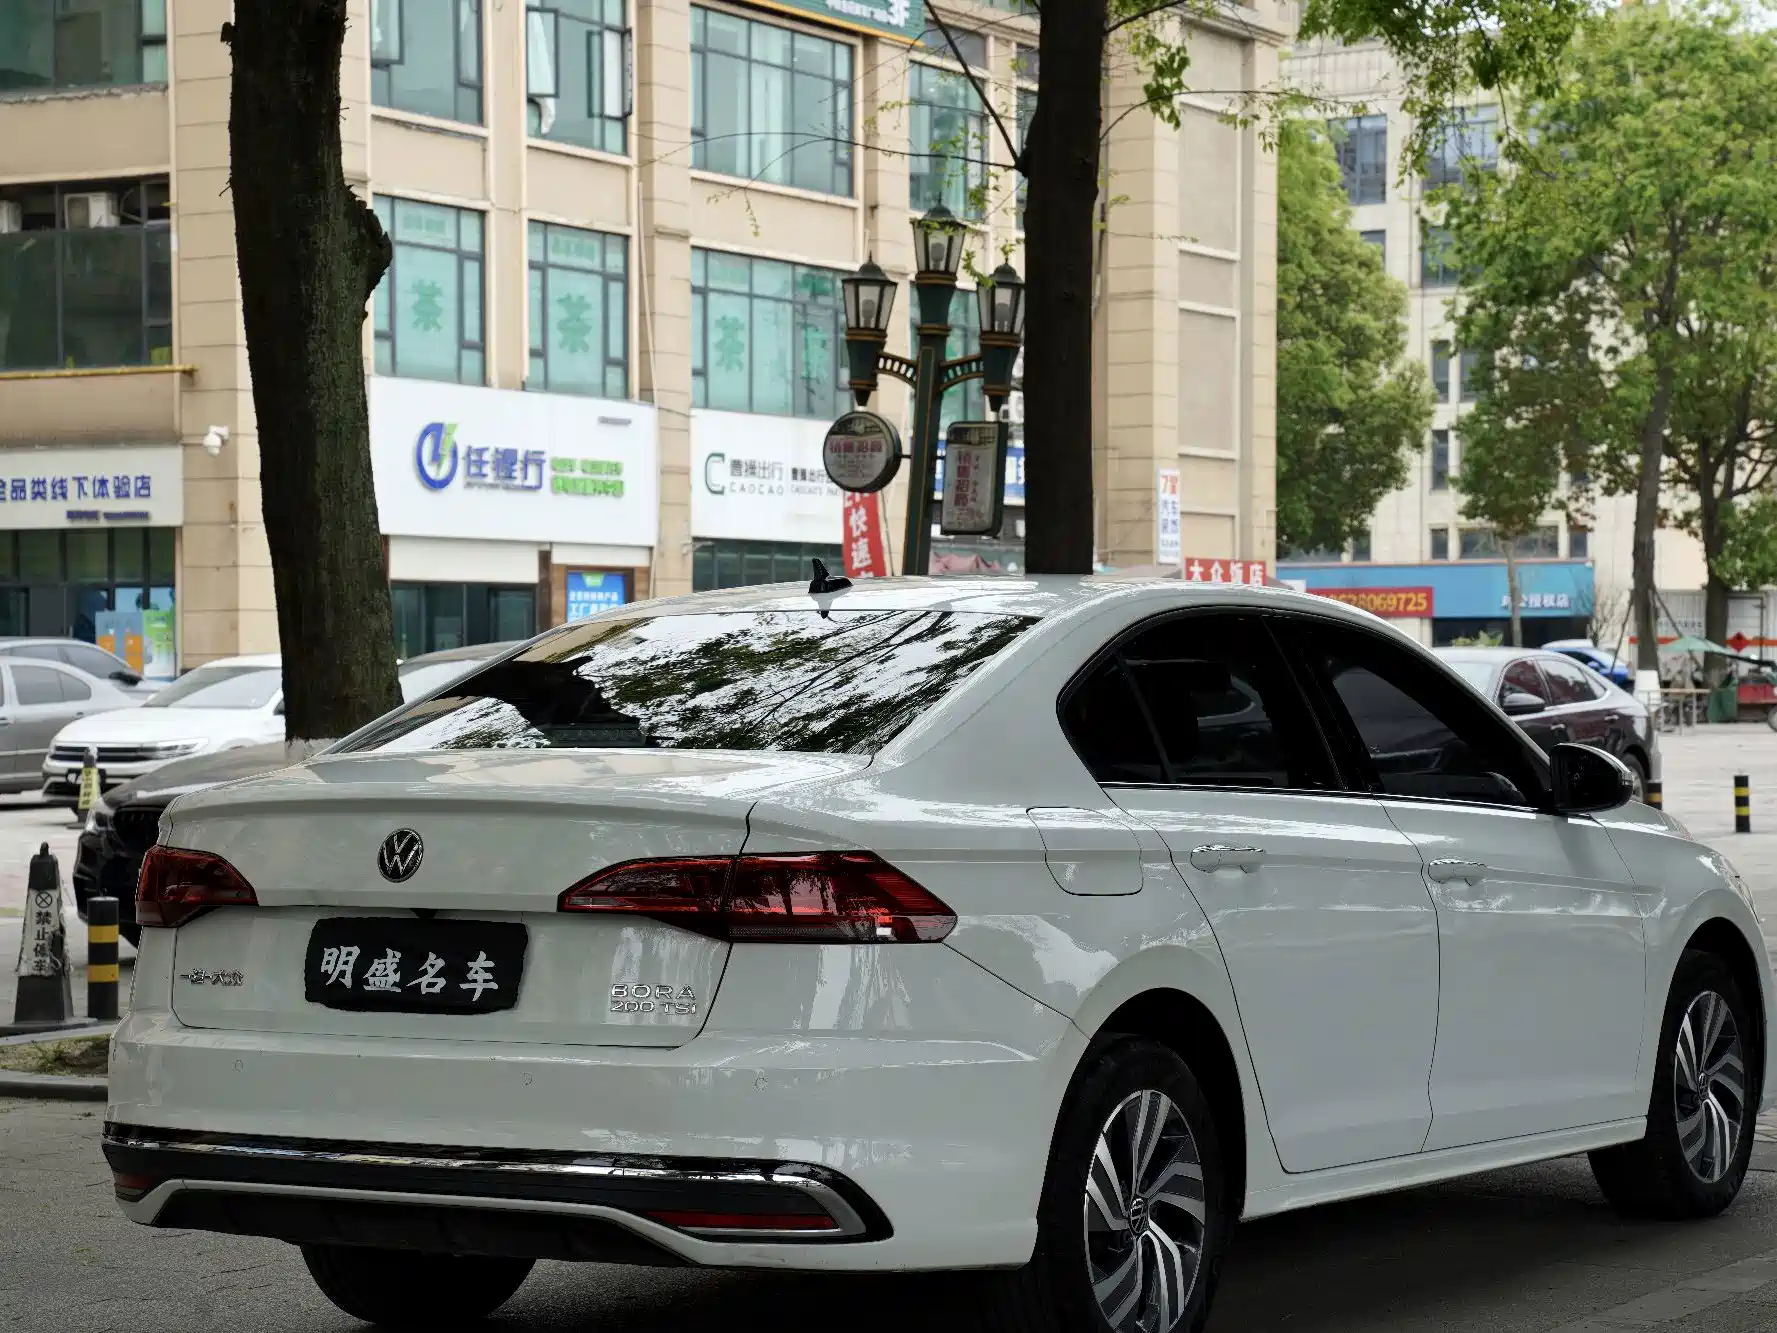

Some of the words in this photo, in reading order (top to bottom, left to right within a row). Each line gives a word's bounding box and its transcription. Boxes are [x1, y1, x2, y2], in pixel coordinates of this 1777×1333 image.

[611, 983, 696, 1000] BORA
[610, 1000, 655, 1013] 200
[660, 1001, 697, 1015] TSI
